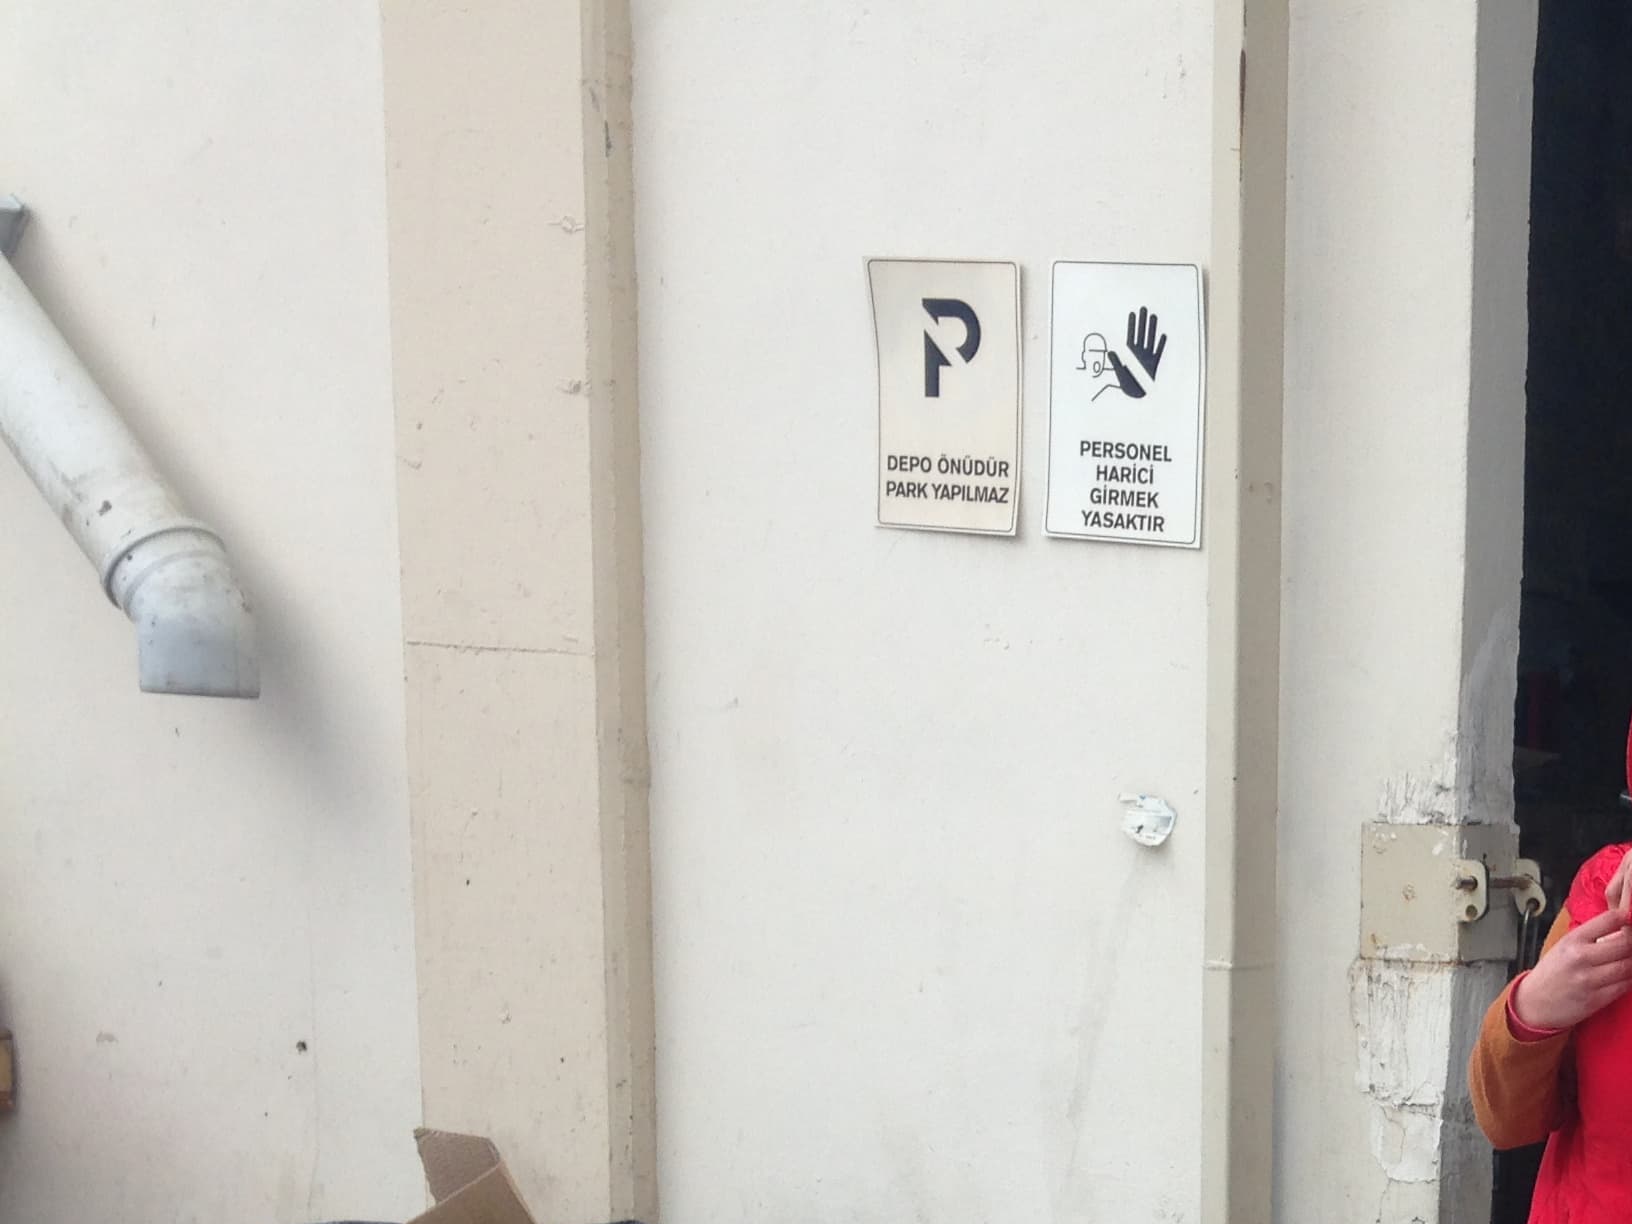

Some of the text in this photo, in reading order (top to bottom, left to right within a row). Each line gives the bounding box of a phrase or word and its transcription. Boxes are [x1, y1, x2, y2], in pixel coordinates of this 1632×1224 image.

[1080, 440, 1172, 462] PERSONEL
[887, 453, 1010, 477] DEPO ÖNÜDÜR
[1096, 463, 1154, 485] HARİCİ
[886, 481, 1010, 504] PARK YAPILMAZ
[1090, 485, 1160, 508] GİRMEK
[1081, 509, 1165, 532] YASAKTIR
